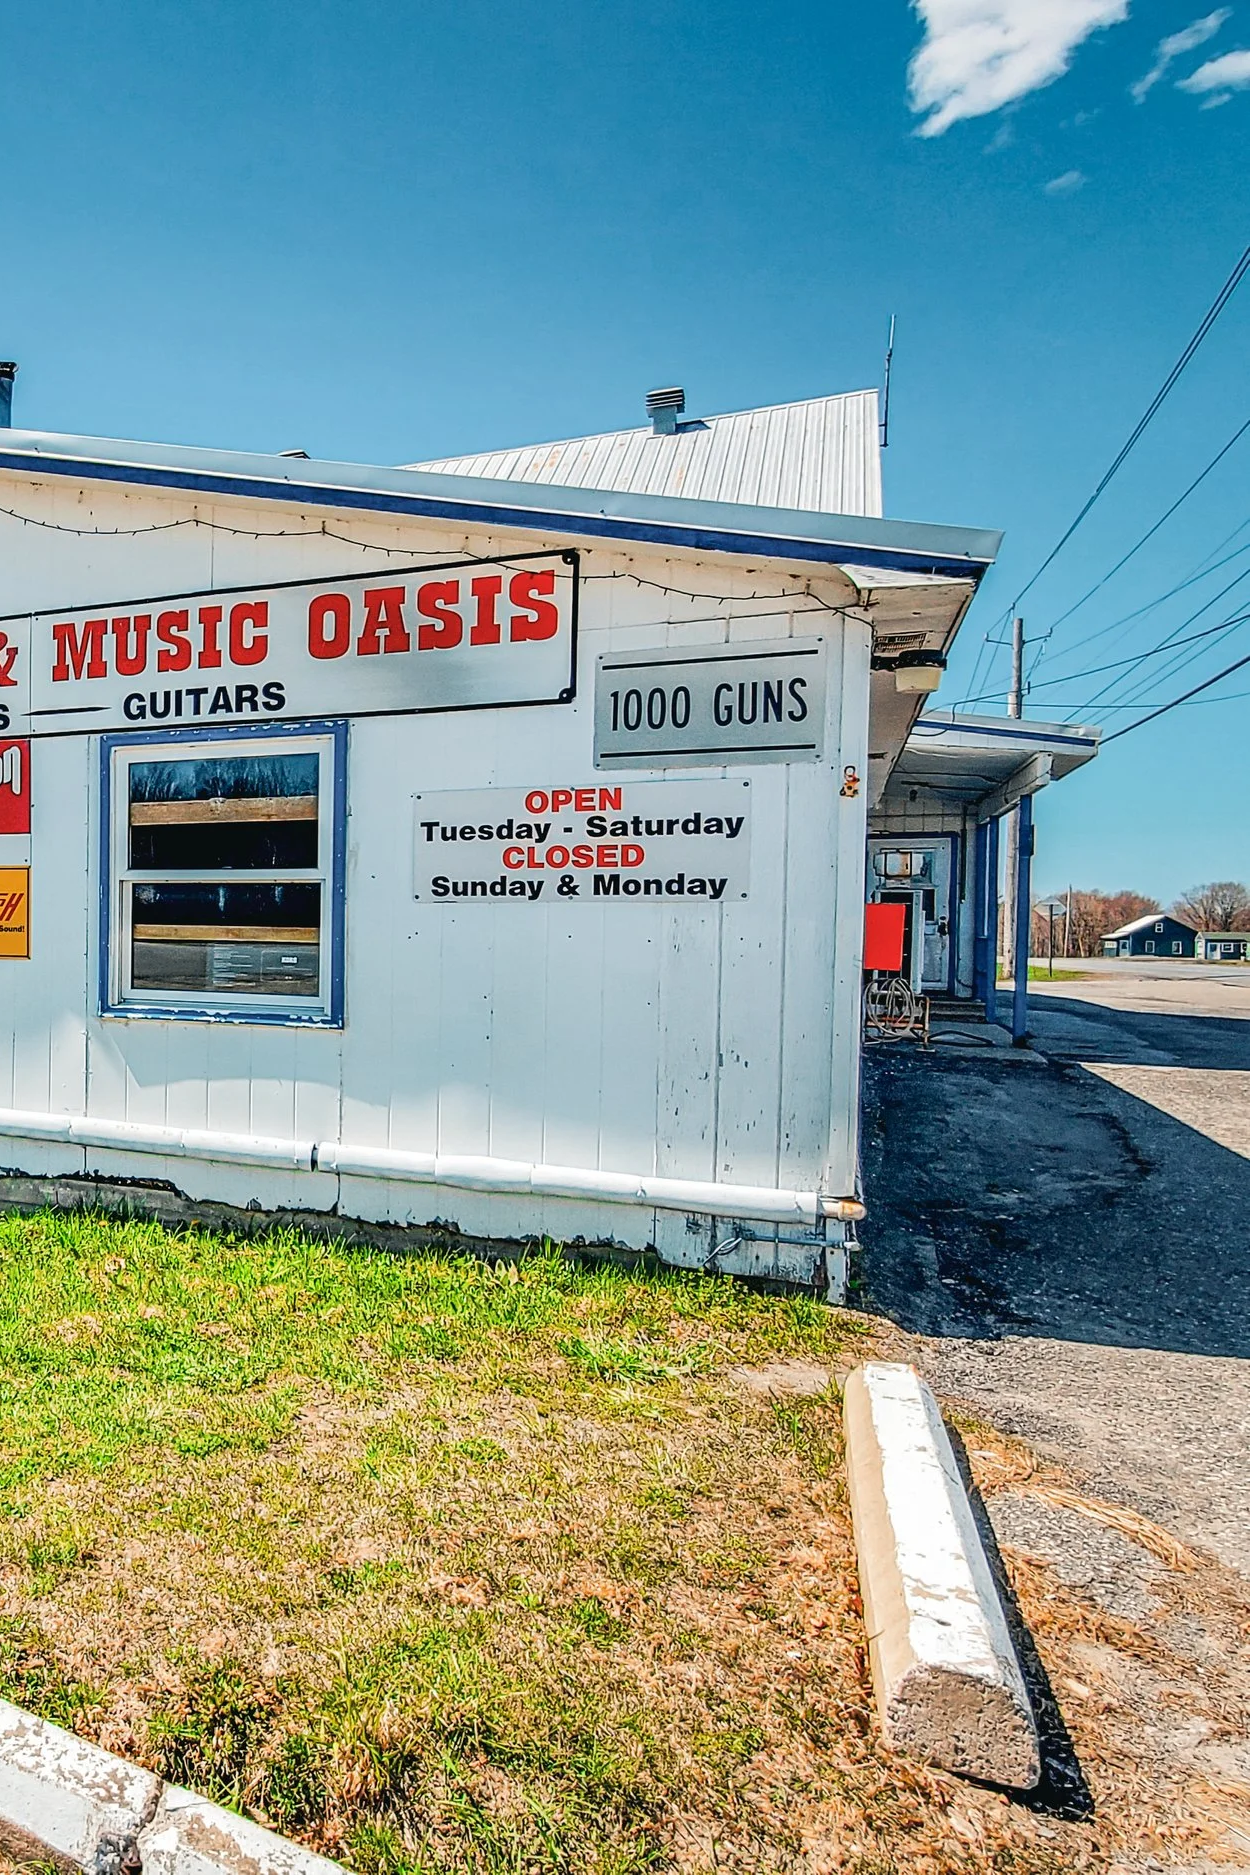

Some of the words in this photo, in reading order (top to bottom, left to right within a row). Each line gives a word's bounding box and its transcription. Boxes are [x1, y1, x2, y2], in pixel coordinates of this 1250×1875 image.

[52, 602, 269, 682] MUSIC
[308, 569, 559, 660] OASIS
[123, 682, 286, 721] GUITARS
[610, 685, 691, 732] 1000
[714, 677, 808, 727] GUNS
[525, 787, 622, 815] OPEN
[421, 818, 551, 843] Tuesday
[586, 812, 745, 839] Saturday
[502, 844, 645, 870] CLOSED
[431, 874, 544, 900] Sunday
[556, 874, 580, 897] &
[593, 873, 728, 899] Monday
[0, 925, 25, 933] Sound!
